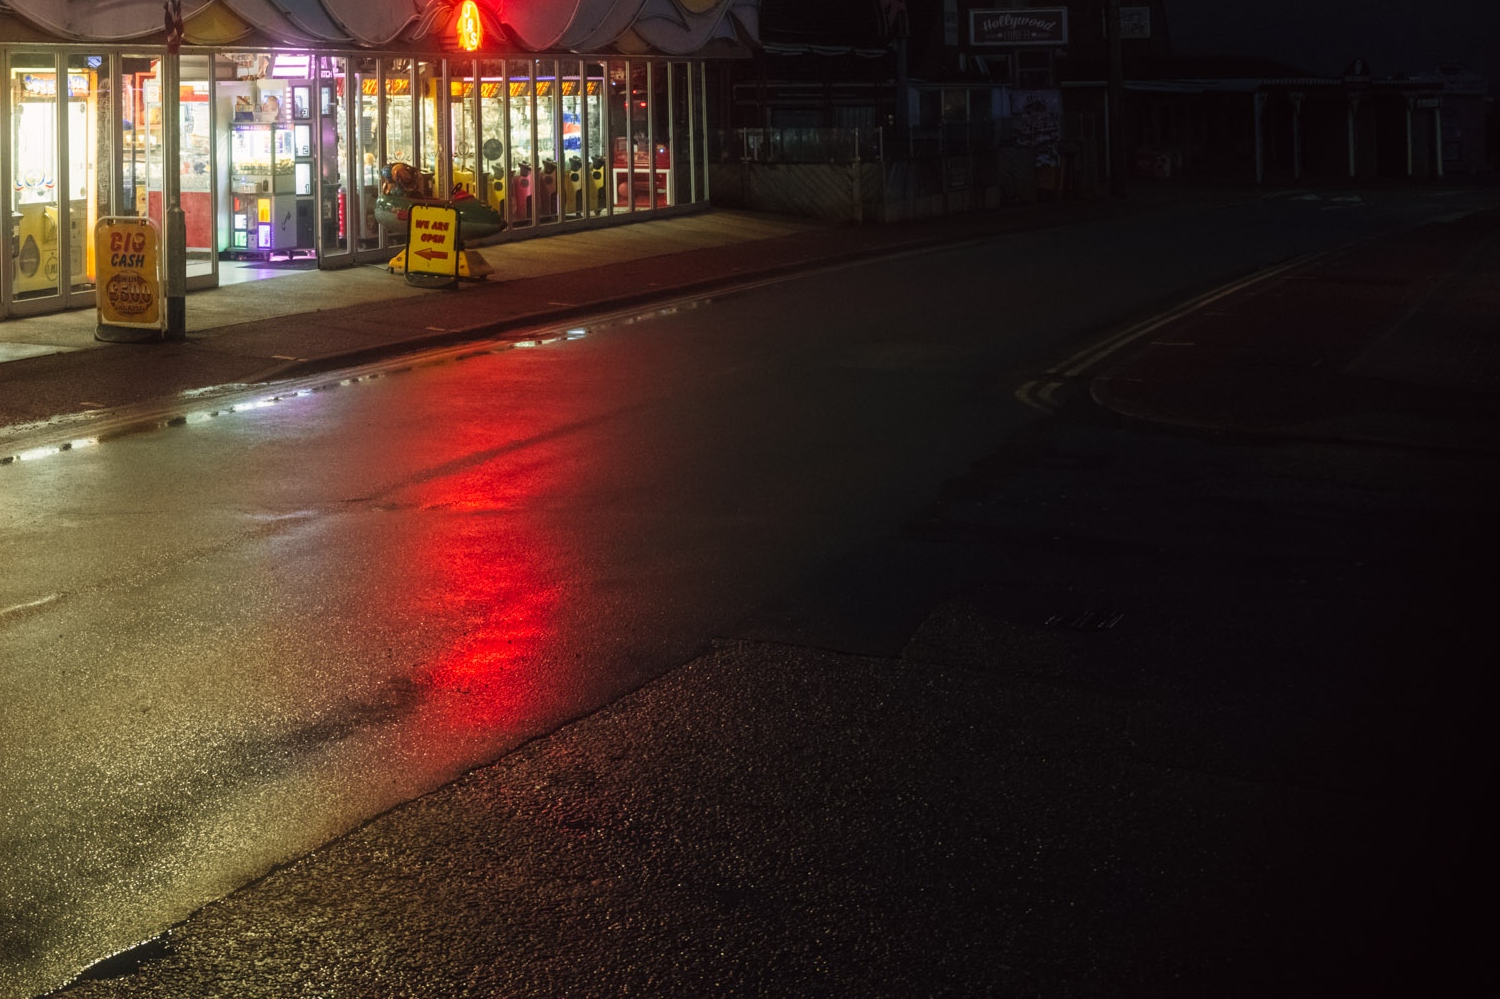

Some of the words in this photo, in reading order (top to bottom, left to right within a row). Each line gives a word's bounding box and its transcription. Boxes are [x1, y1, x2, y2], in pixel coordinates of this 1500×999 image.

[982, 13, 1058, 32] Hollywood
[415, 220, 430, 229] WE
[431, 221, 450, 231] ARE
[420, 233, 446, 244] OPEN
[111, 253, 145, 268] CASH
